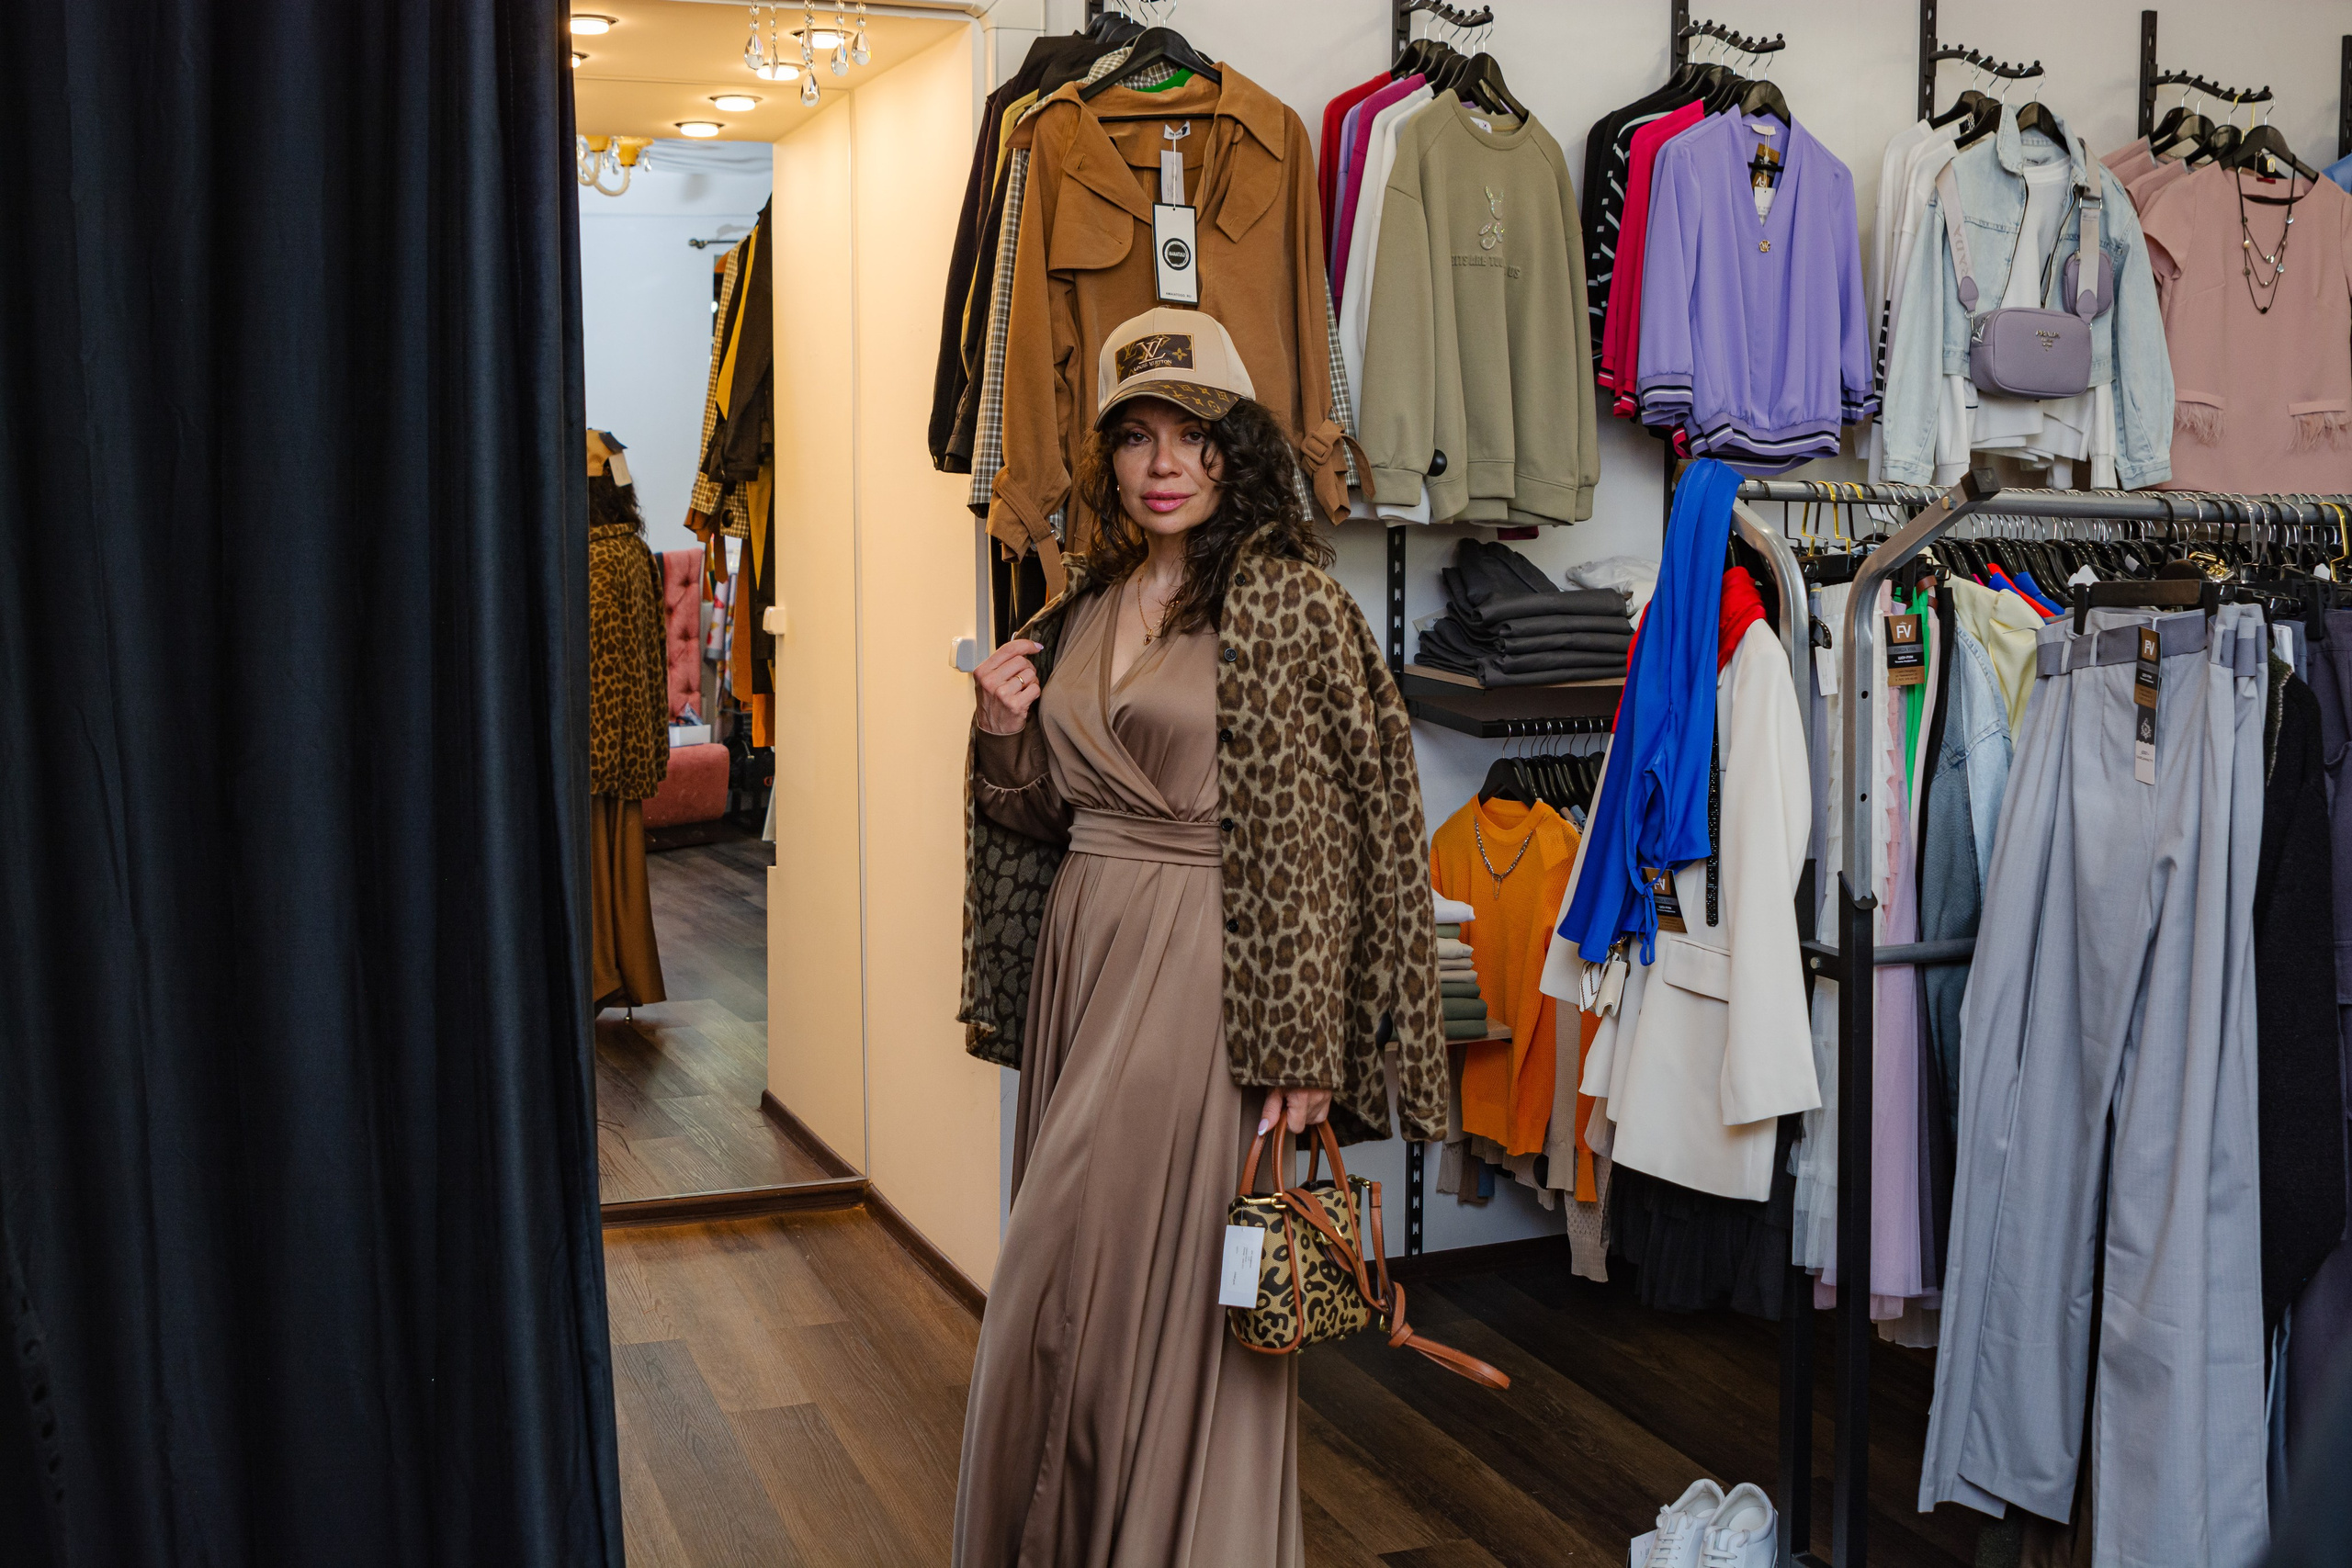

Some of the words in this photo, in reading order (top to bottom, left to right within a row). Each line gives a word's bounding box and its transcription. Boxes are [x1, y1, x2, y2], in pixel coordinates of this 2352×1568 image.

[1953, 224, 1970, 279] RADA
[1507, 265, 1521, 278] US
[1133, 363, 1148, 372] LOUIS
[1896, 625, 1912, 638] FV
